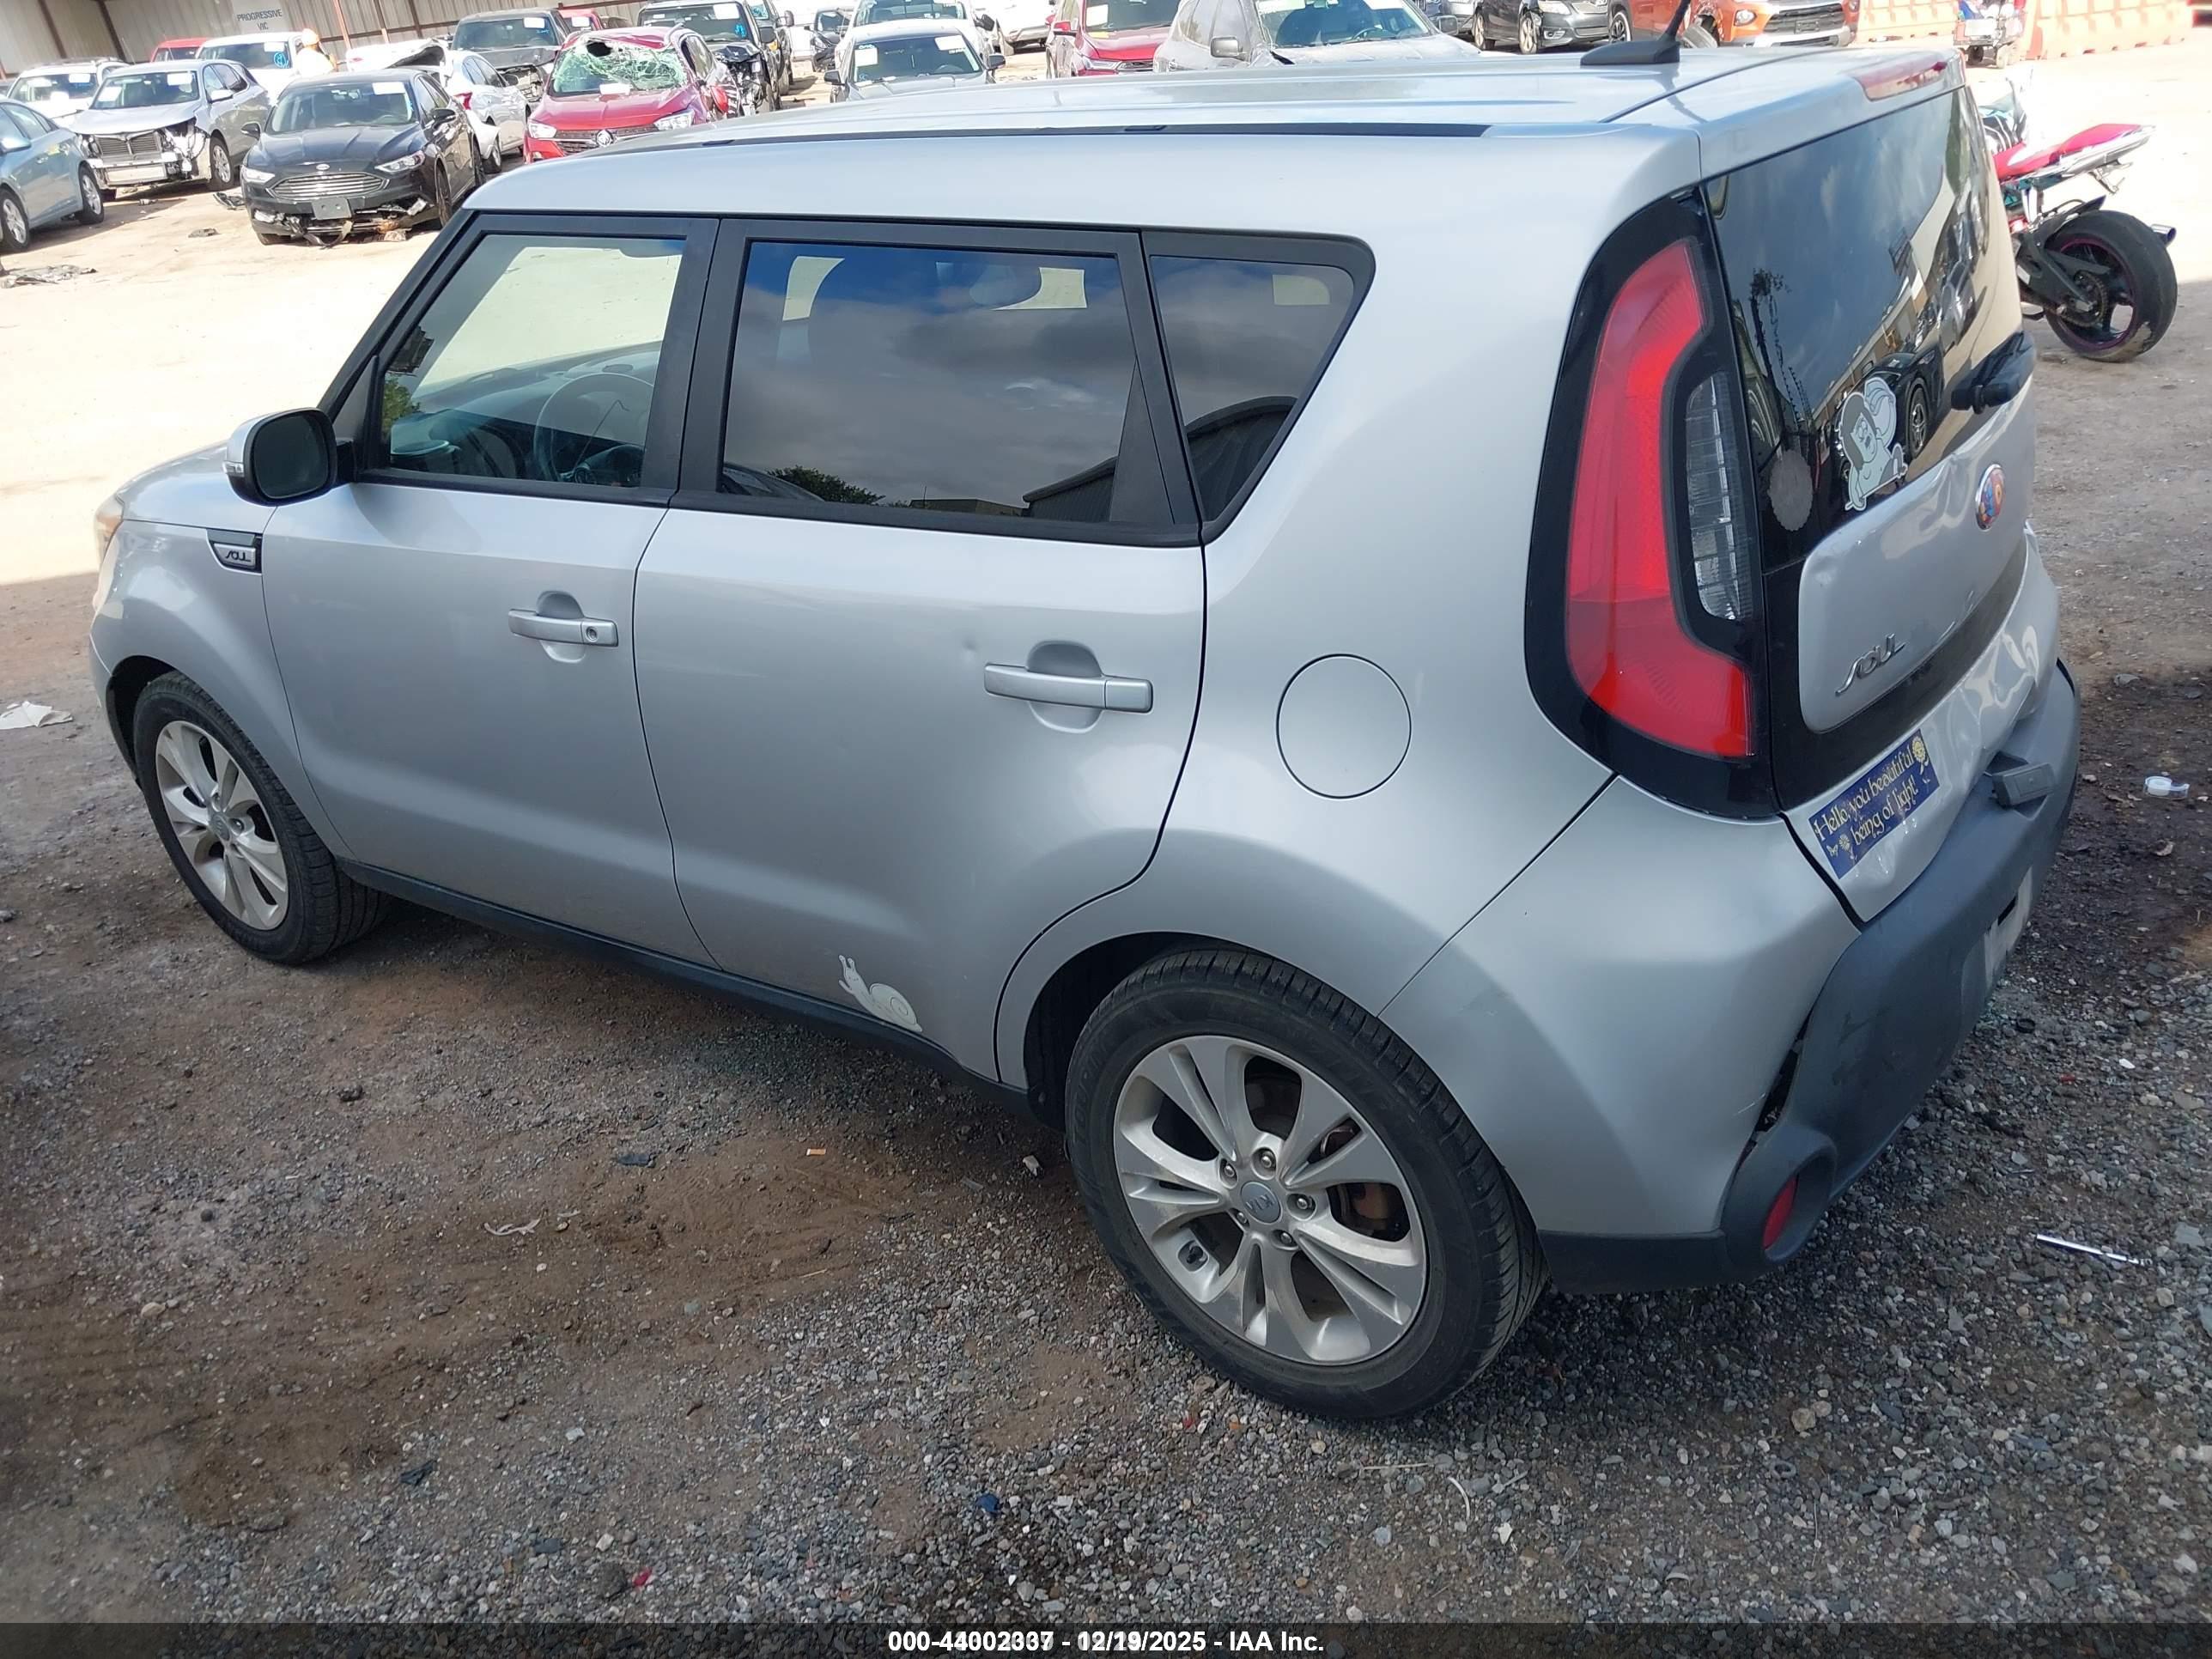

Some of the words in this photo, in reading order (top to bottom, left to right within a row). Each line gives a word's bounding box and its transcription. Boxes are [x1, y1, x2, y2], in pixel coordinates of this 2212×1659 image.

[236, 9, 283, 21] PROGRESSIVE
[257, 21, 269, 31] VIC
[1814, 804, 1850, 841] Hello,
[1849, 787, 1869, 821] you
[1869, 745, 1915, 798] beautiful
[1850, 814, 1885, 846] being
[1881, 795, 1895, 820] of
[1894, 774, 1919, 811] light!
